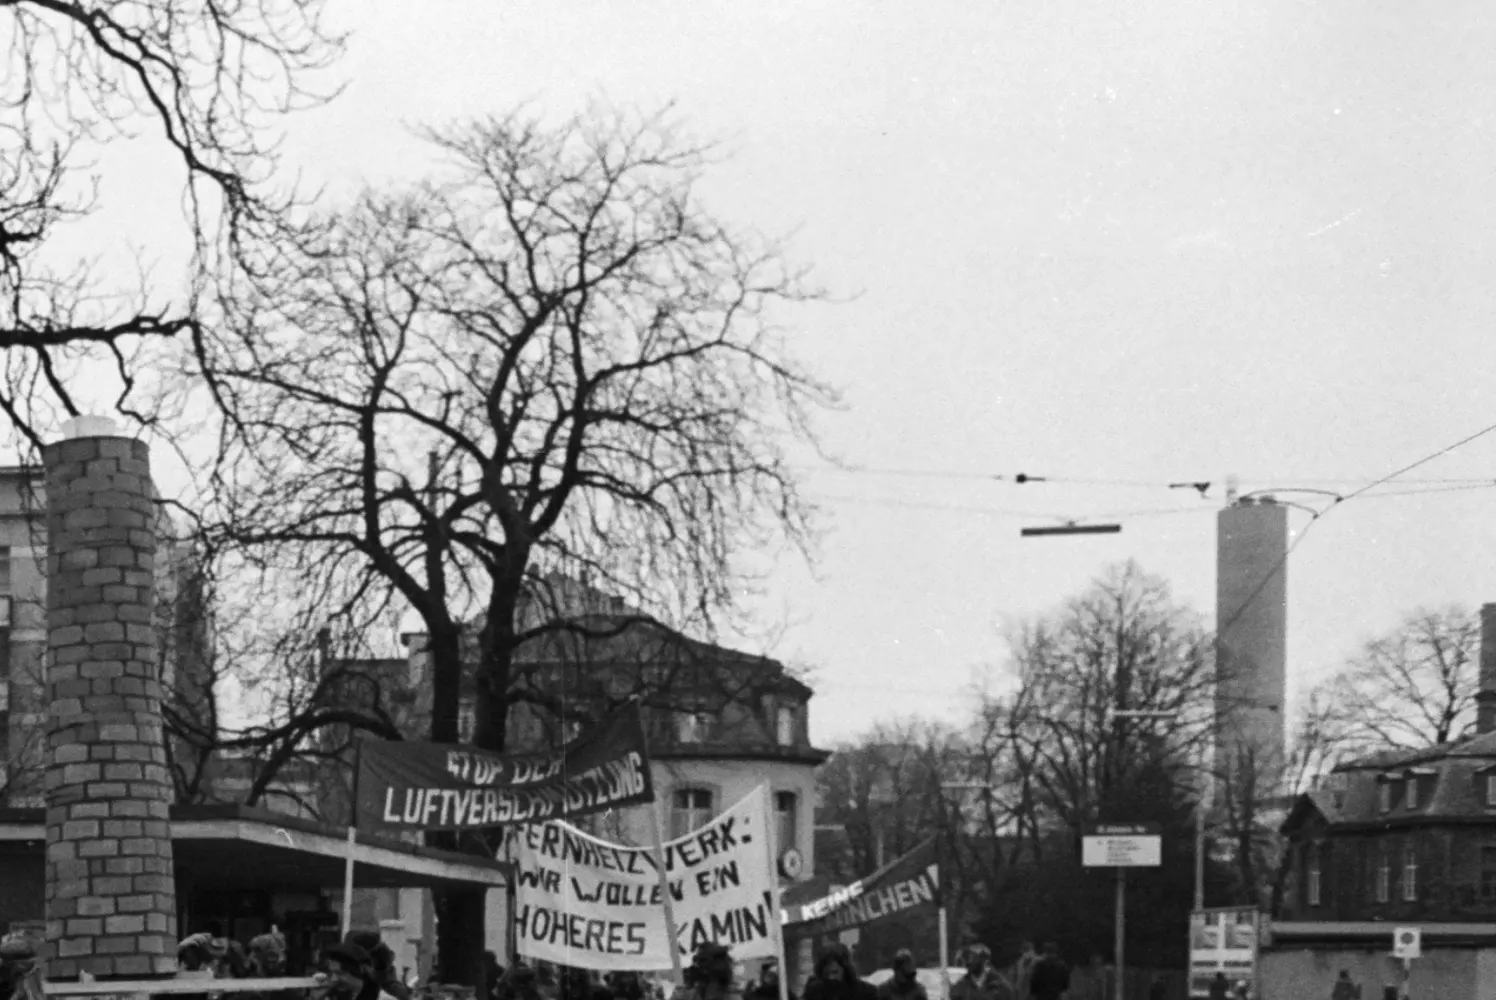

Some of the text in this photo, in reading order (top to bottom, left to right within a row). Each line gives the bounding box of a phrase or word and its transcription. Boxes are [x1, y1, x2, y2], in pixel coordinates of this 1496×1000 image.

[446, 750, 504, 786] STOP
[696, 860, 741, 897] EIN
[801, 879, 865, 921] KEINE
